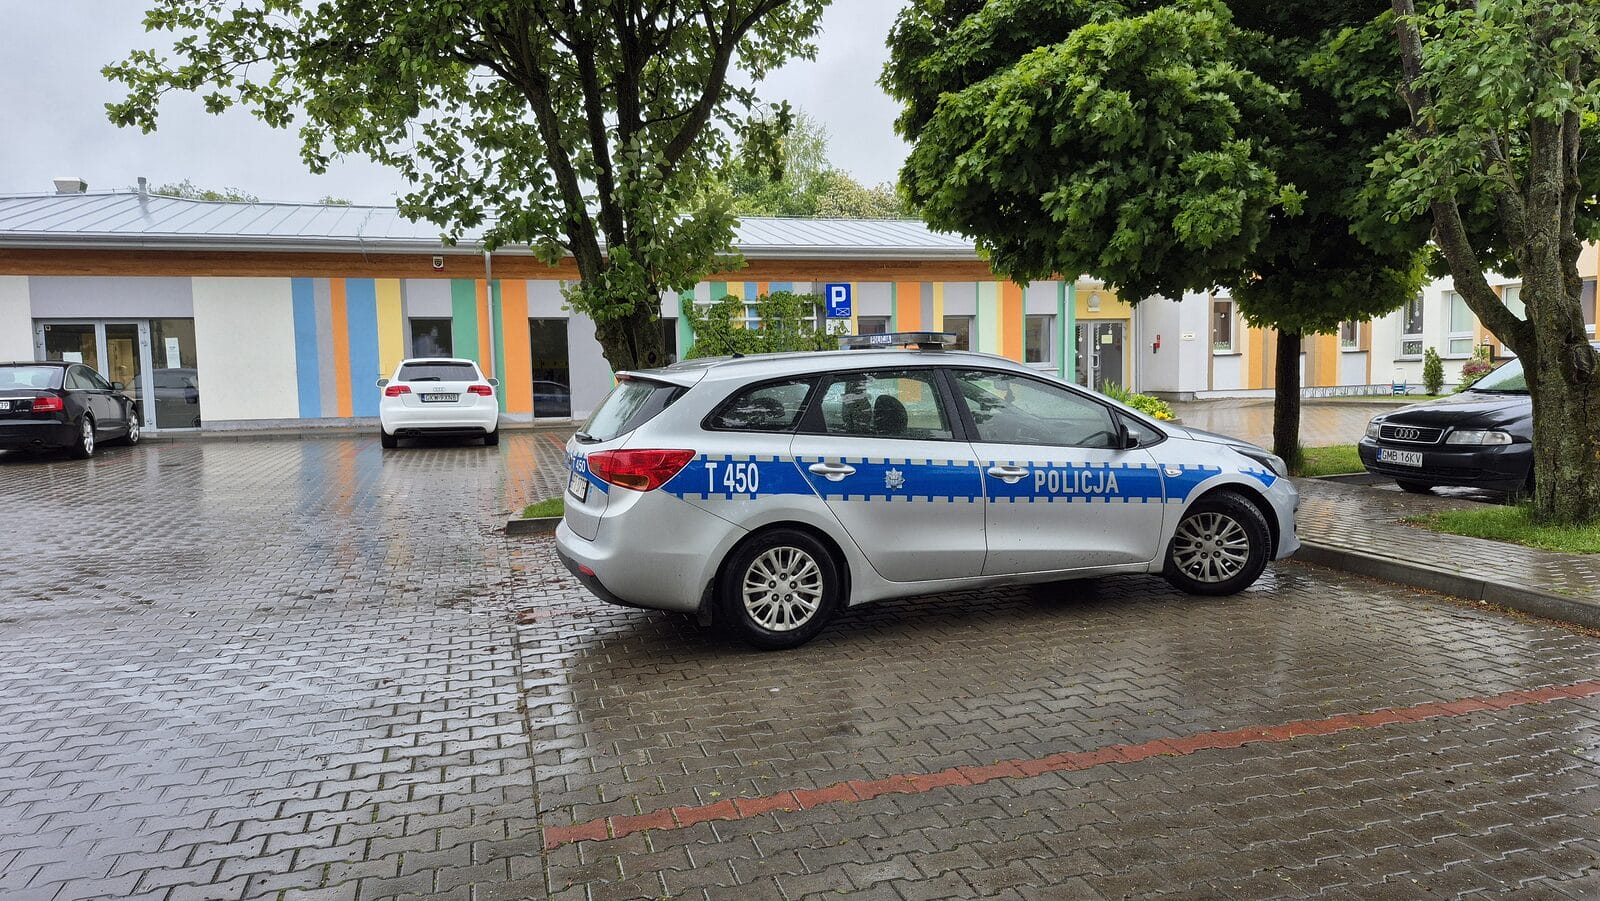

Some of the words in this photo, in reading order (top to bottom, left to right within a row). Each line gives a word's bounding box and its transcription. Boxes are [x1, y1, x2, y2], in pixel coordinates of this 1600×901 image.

[831, 286, 847, 308] P
[576, 459, 586, 473] 450
[1382, 450, 1398, 460] GMB
[1400, 452, 1421, 463] 16KV
[705, 462, 718, 492] T
[723, 463, 759, 493] 450
[1034, 470, 1119, 494] POLICJA
